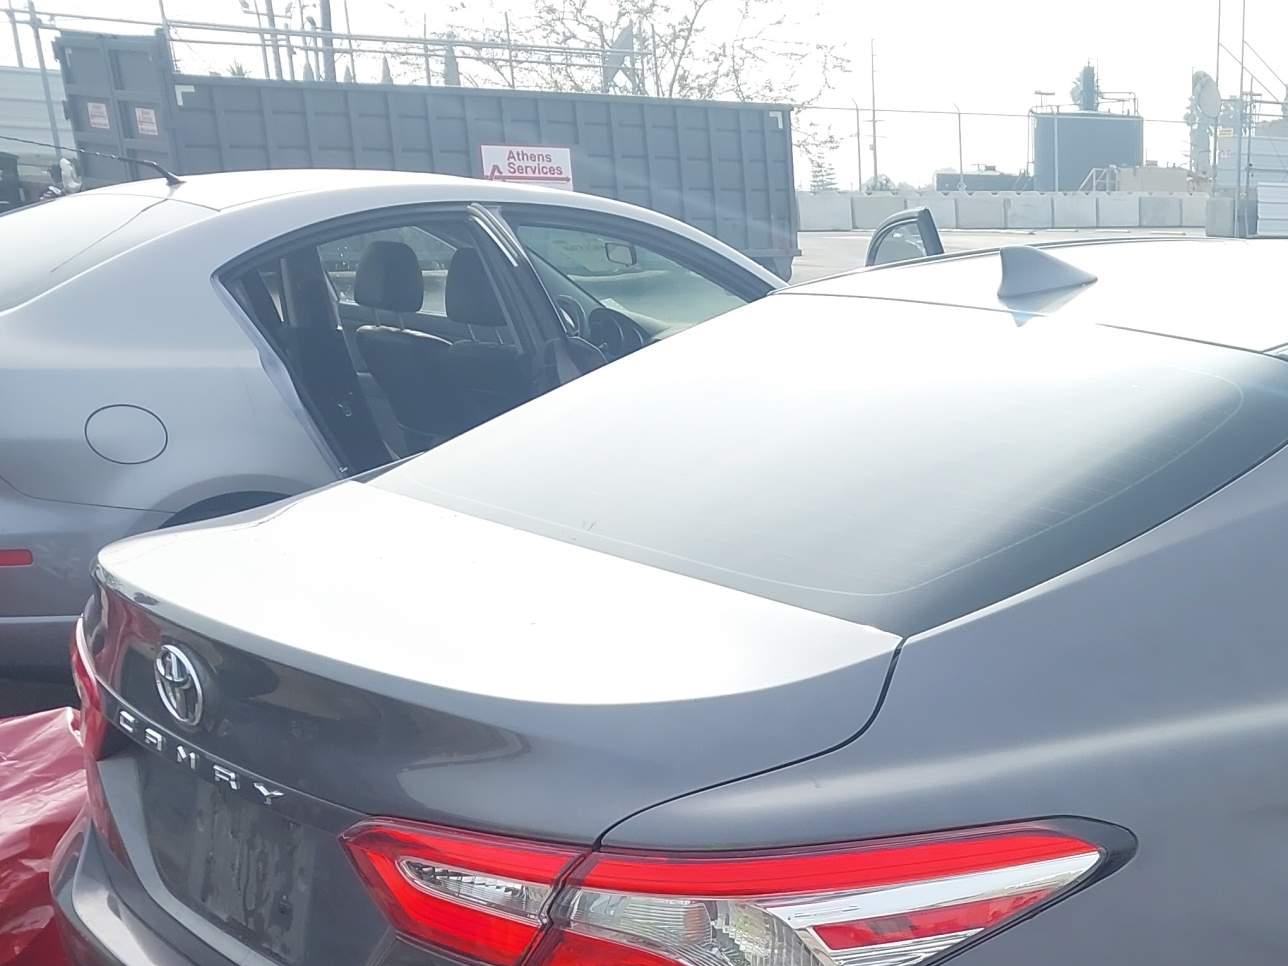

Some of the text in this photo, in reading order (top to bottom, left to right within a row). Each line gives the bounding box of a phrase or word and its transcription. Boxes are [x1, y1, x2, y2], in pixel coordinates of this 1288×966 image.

[507, 150, 552, 163] Athens
[507, 162, 563, 175] Services
[119, 710, 285, 806] CAMRY
